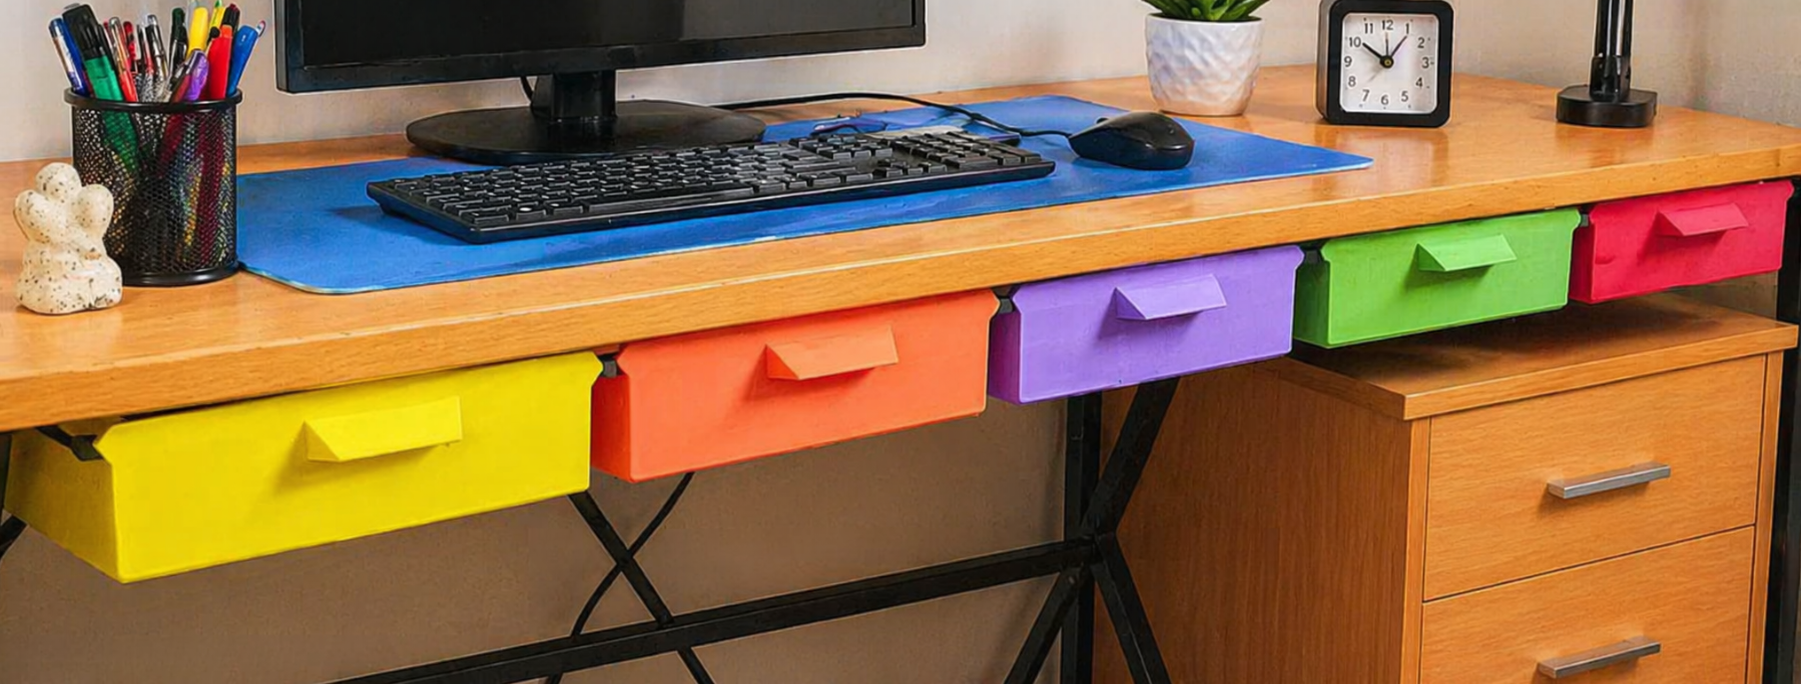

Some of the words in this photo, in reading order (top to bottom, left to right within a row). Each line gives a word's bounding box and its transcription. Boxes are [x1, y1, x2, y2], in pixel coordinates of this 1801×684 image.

[1364, 23, 1373, 34] 11
[1381, 20, 1394, 30] 12
[1405, 23, 1410, 34] 1
[1349, 36, 1361, 48] 10
[1417, 37, 1425, 48] 2
[1344, 56, 1352, 67] 9
[1421, 57, 1429, 69] 3
[1348, 76, 1356, 87] 8
[1415, 77, 1423, 88] 4
[1362, 89, 1370, 101] 7
[1381, 94, 1389, 105] 6
[1401, 91, 1409, 102] 5
